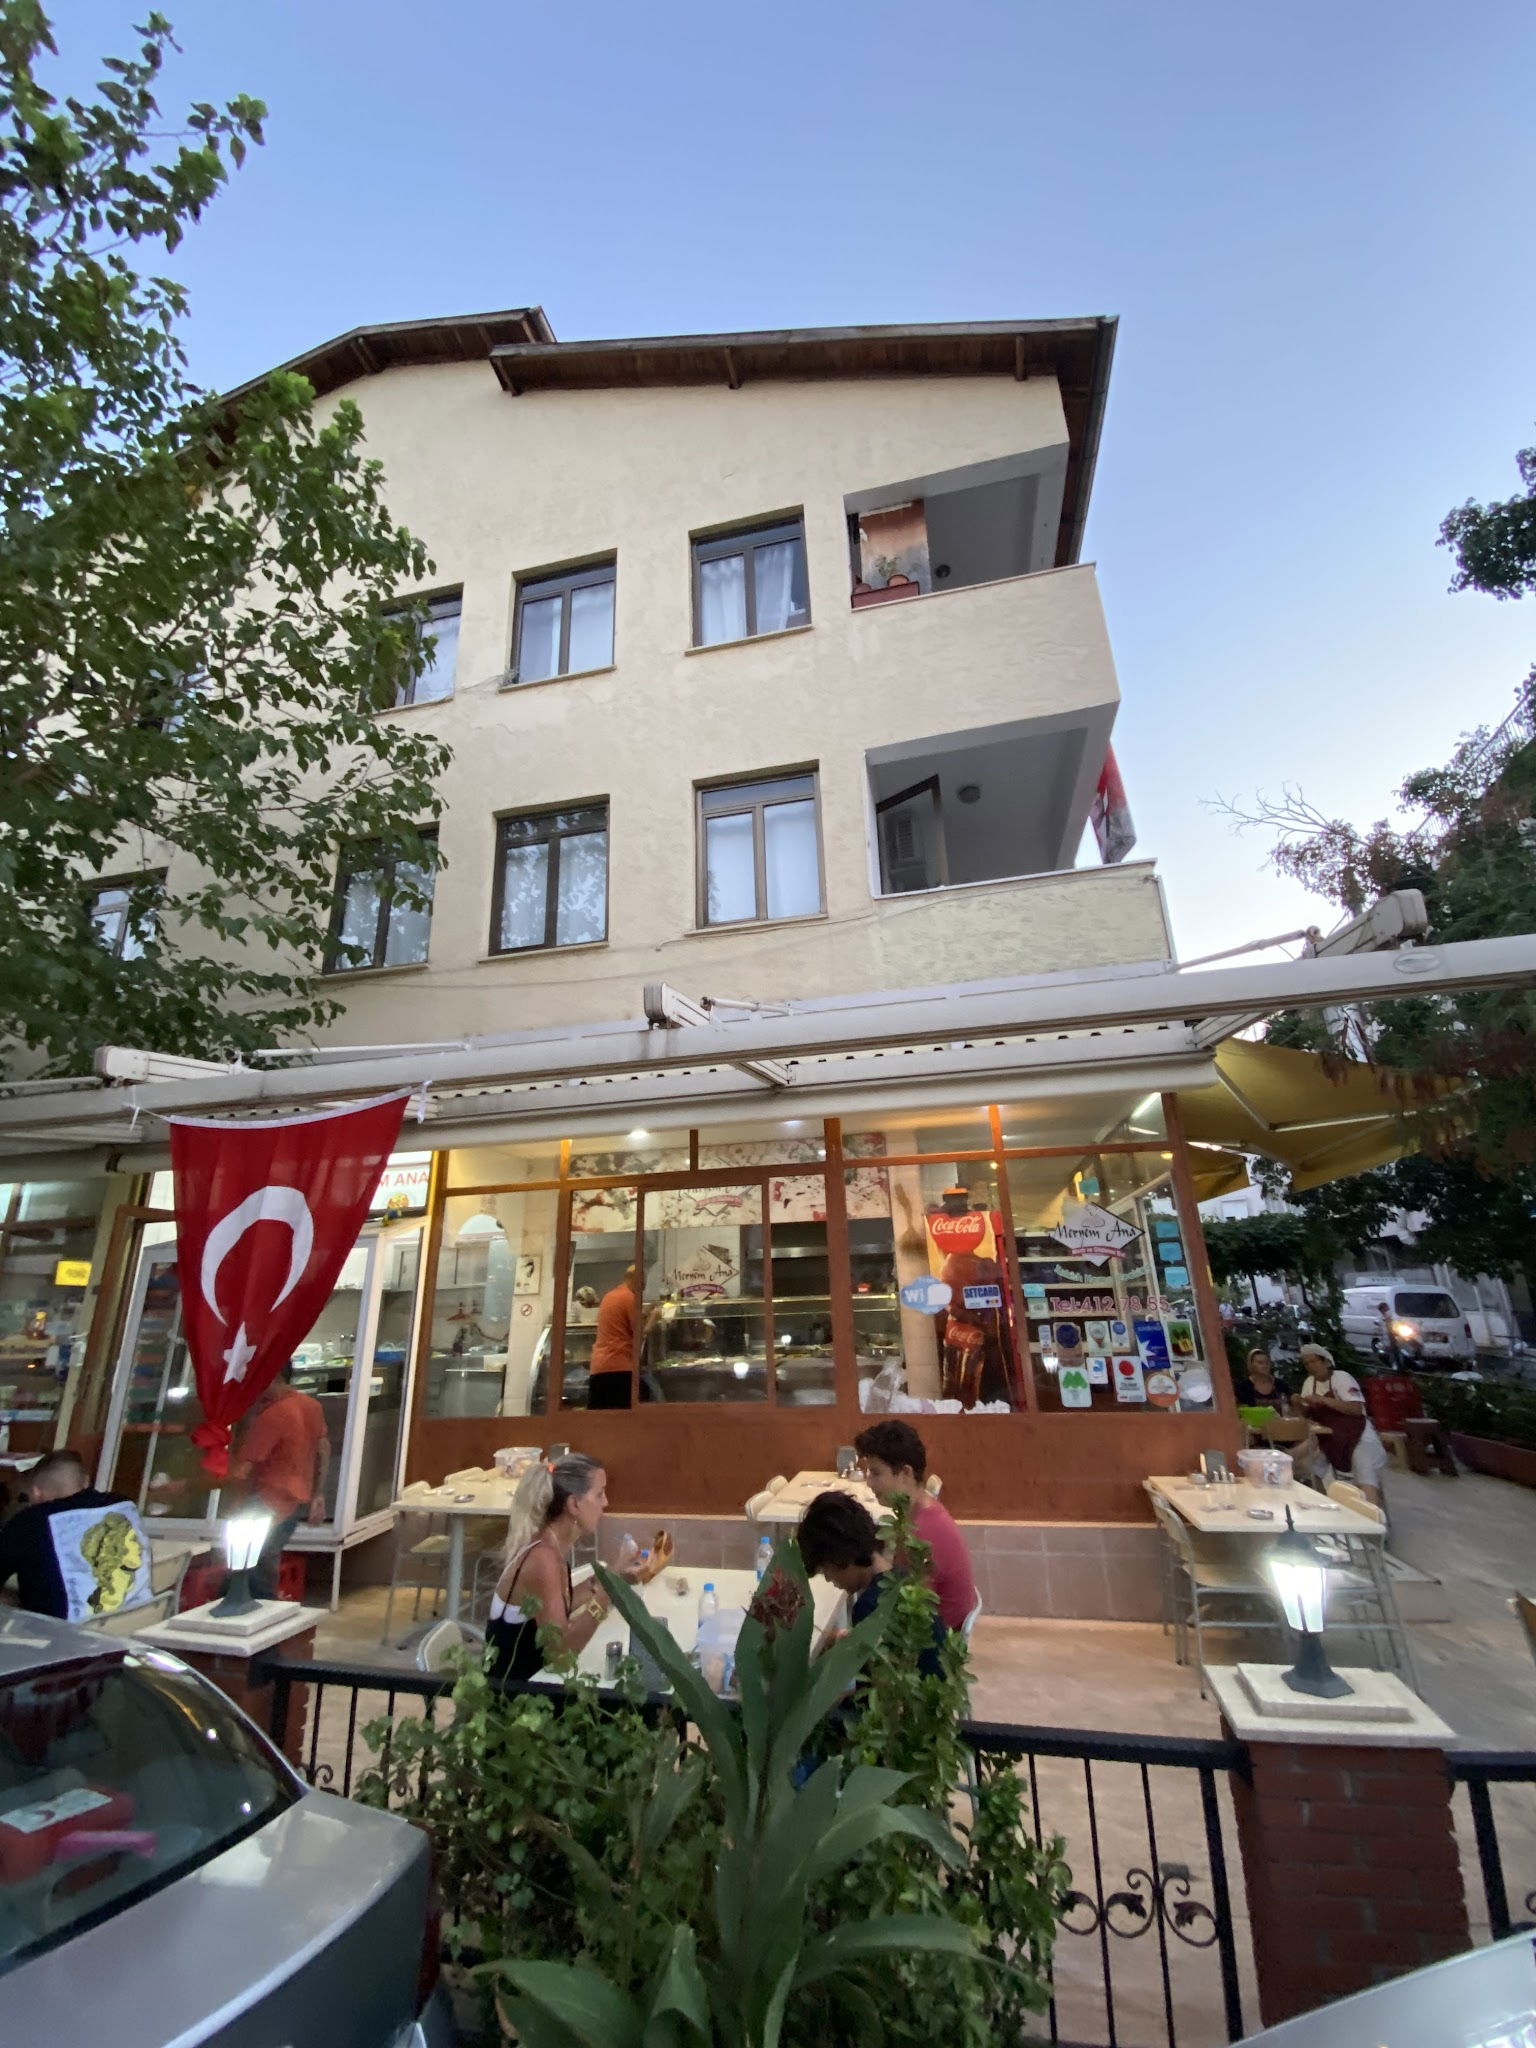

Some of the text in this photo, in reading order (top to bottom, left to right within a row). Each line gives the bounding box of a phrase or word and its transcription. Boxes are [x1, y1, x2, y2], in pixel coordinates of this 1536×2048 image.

[394, 1170, 430, 1186] ANA
[932, 1215, 982, 1236] Coca-Cola
[1052, 1220, 1137, 1248] Meryem Ana
[963, 1286, 999, 1299] SETCARD
[1120, 1295, 1142, 1313] 78
[1147, 1295, 1170, 1312] 55
